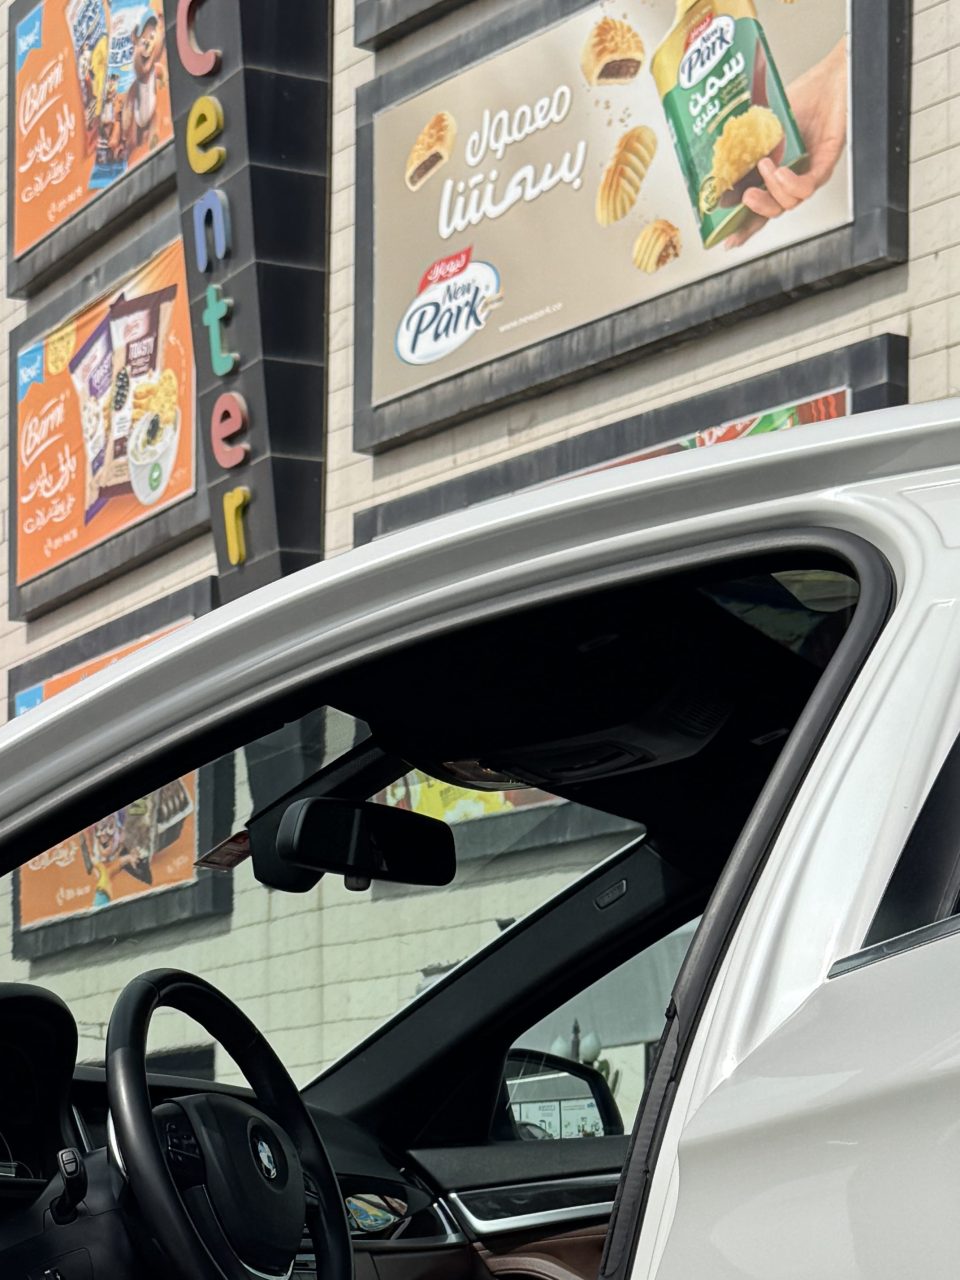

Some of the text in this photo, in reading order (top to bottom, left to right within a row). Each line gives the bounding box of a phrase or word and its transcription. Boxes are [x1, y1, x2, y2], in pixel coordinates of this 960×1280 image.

[681, 27, 731, 83] Park
[465, 84, 572, 167] معمول
[405, 286, 482, 354] Park
[442, 283, 471, 305] New
